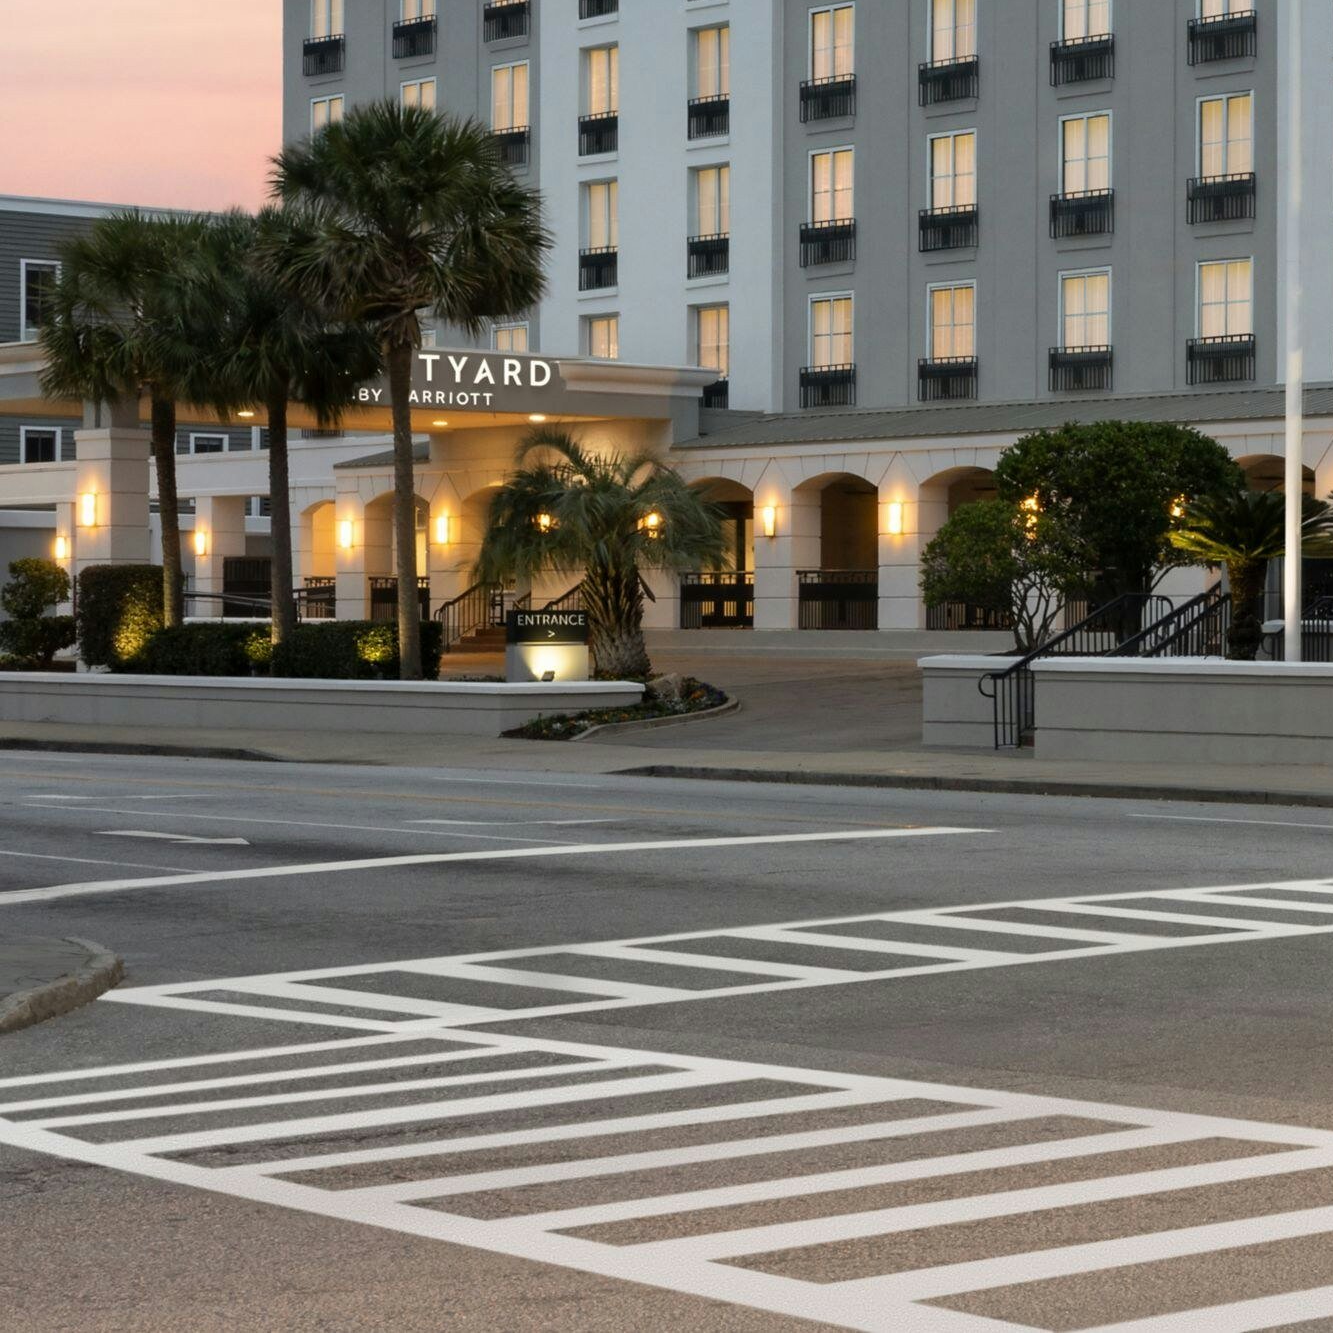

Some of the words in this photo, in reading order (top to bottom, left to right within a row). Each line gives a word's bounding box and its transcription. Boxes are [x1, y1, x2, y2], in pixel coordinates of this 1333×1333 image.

[358, 388, 382, 402] BY
[408, 390, 493, 406] ARRIOTT
[517, 614, 585, 626] ENTRANCE
